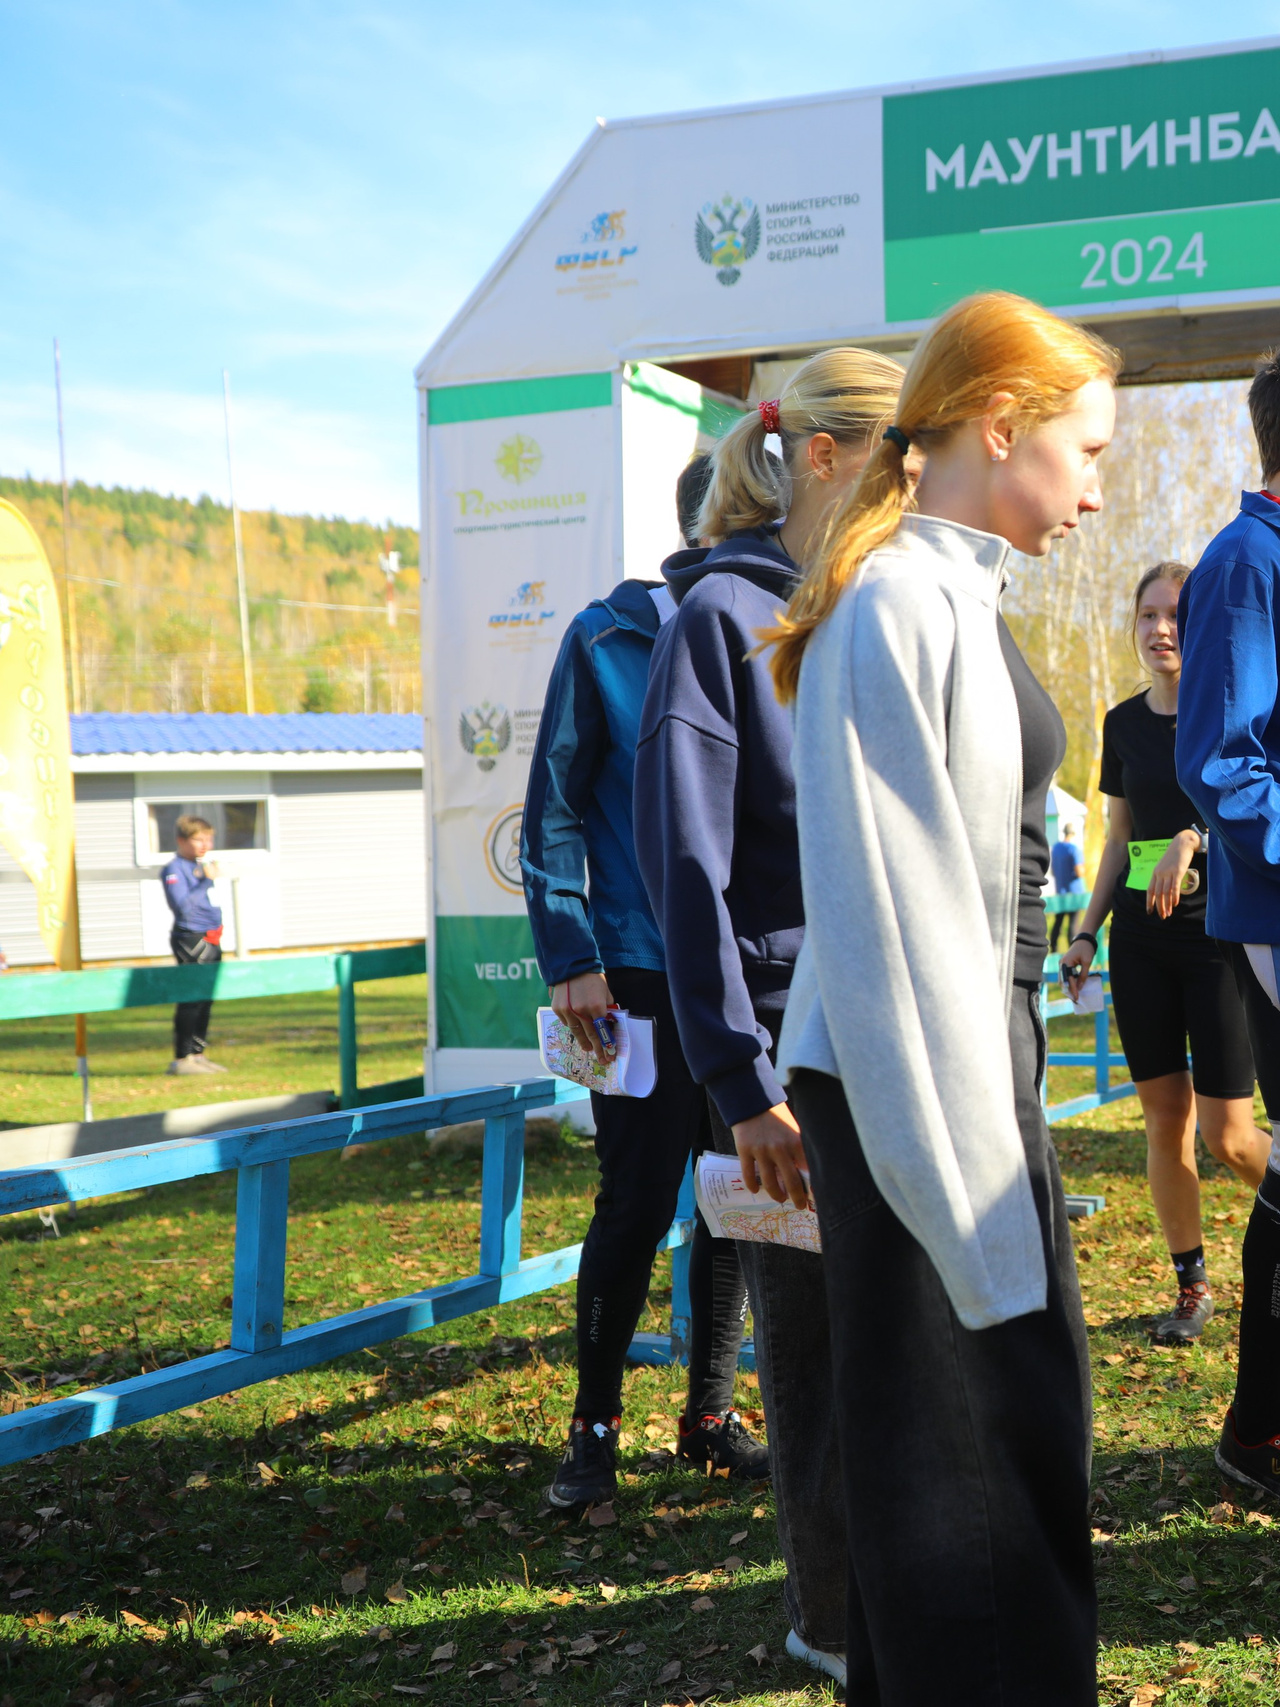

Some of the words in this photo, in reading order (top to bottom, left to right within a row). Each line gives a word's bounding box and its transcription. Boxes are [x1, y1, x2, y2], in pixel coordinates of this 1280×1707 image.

[765, 193, 860, 214] МИНИСТЕРСТВО
[766, 215, 812, 229] СПОРТА
[766, 226, 845, 246] РОССИЙСКОЙ
[767, 244, 839, 262] ФЕДЕРАЦИИ
[1080, 231, 1208, 289] 2024
[731, 1178, 745, 1191] 1.1
